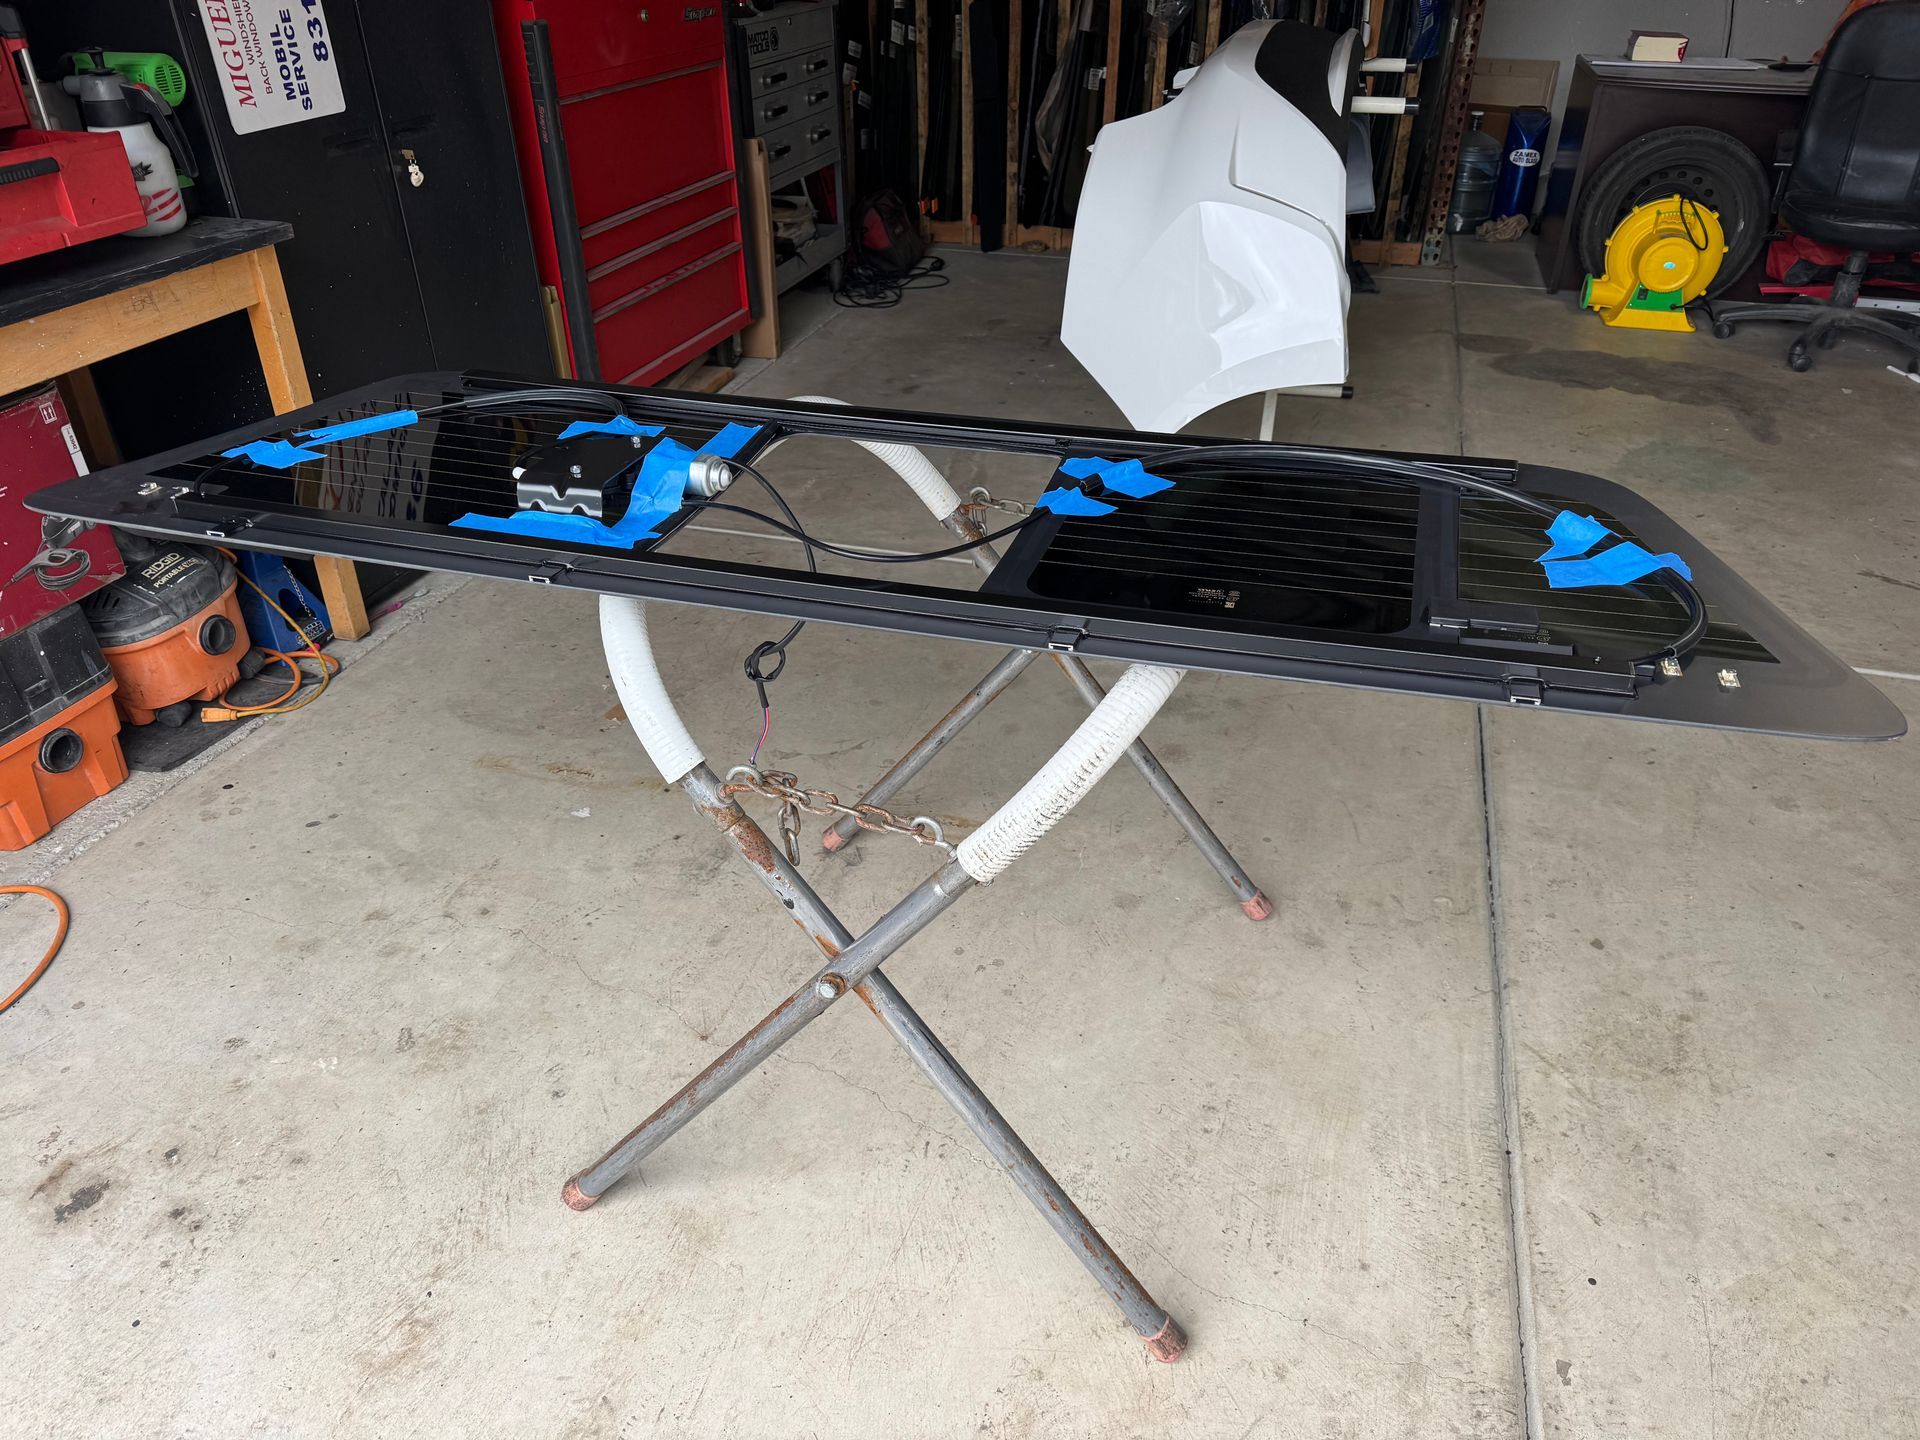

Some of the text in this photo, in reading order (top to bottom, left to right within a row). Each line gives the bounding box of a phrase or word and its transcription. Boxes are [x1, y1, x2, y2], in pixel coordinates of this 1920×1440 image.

[231, 0, 255, 65] WINDSHIE
[750, 41, 770, 56] TOOLS
[260, 61, 273, 94] BACK
[270, 24, 296, 100] MOBIL
[279, 9, 312, 110] SERVICE
[141, 553, 180, 578] RIDGID
